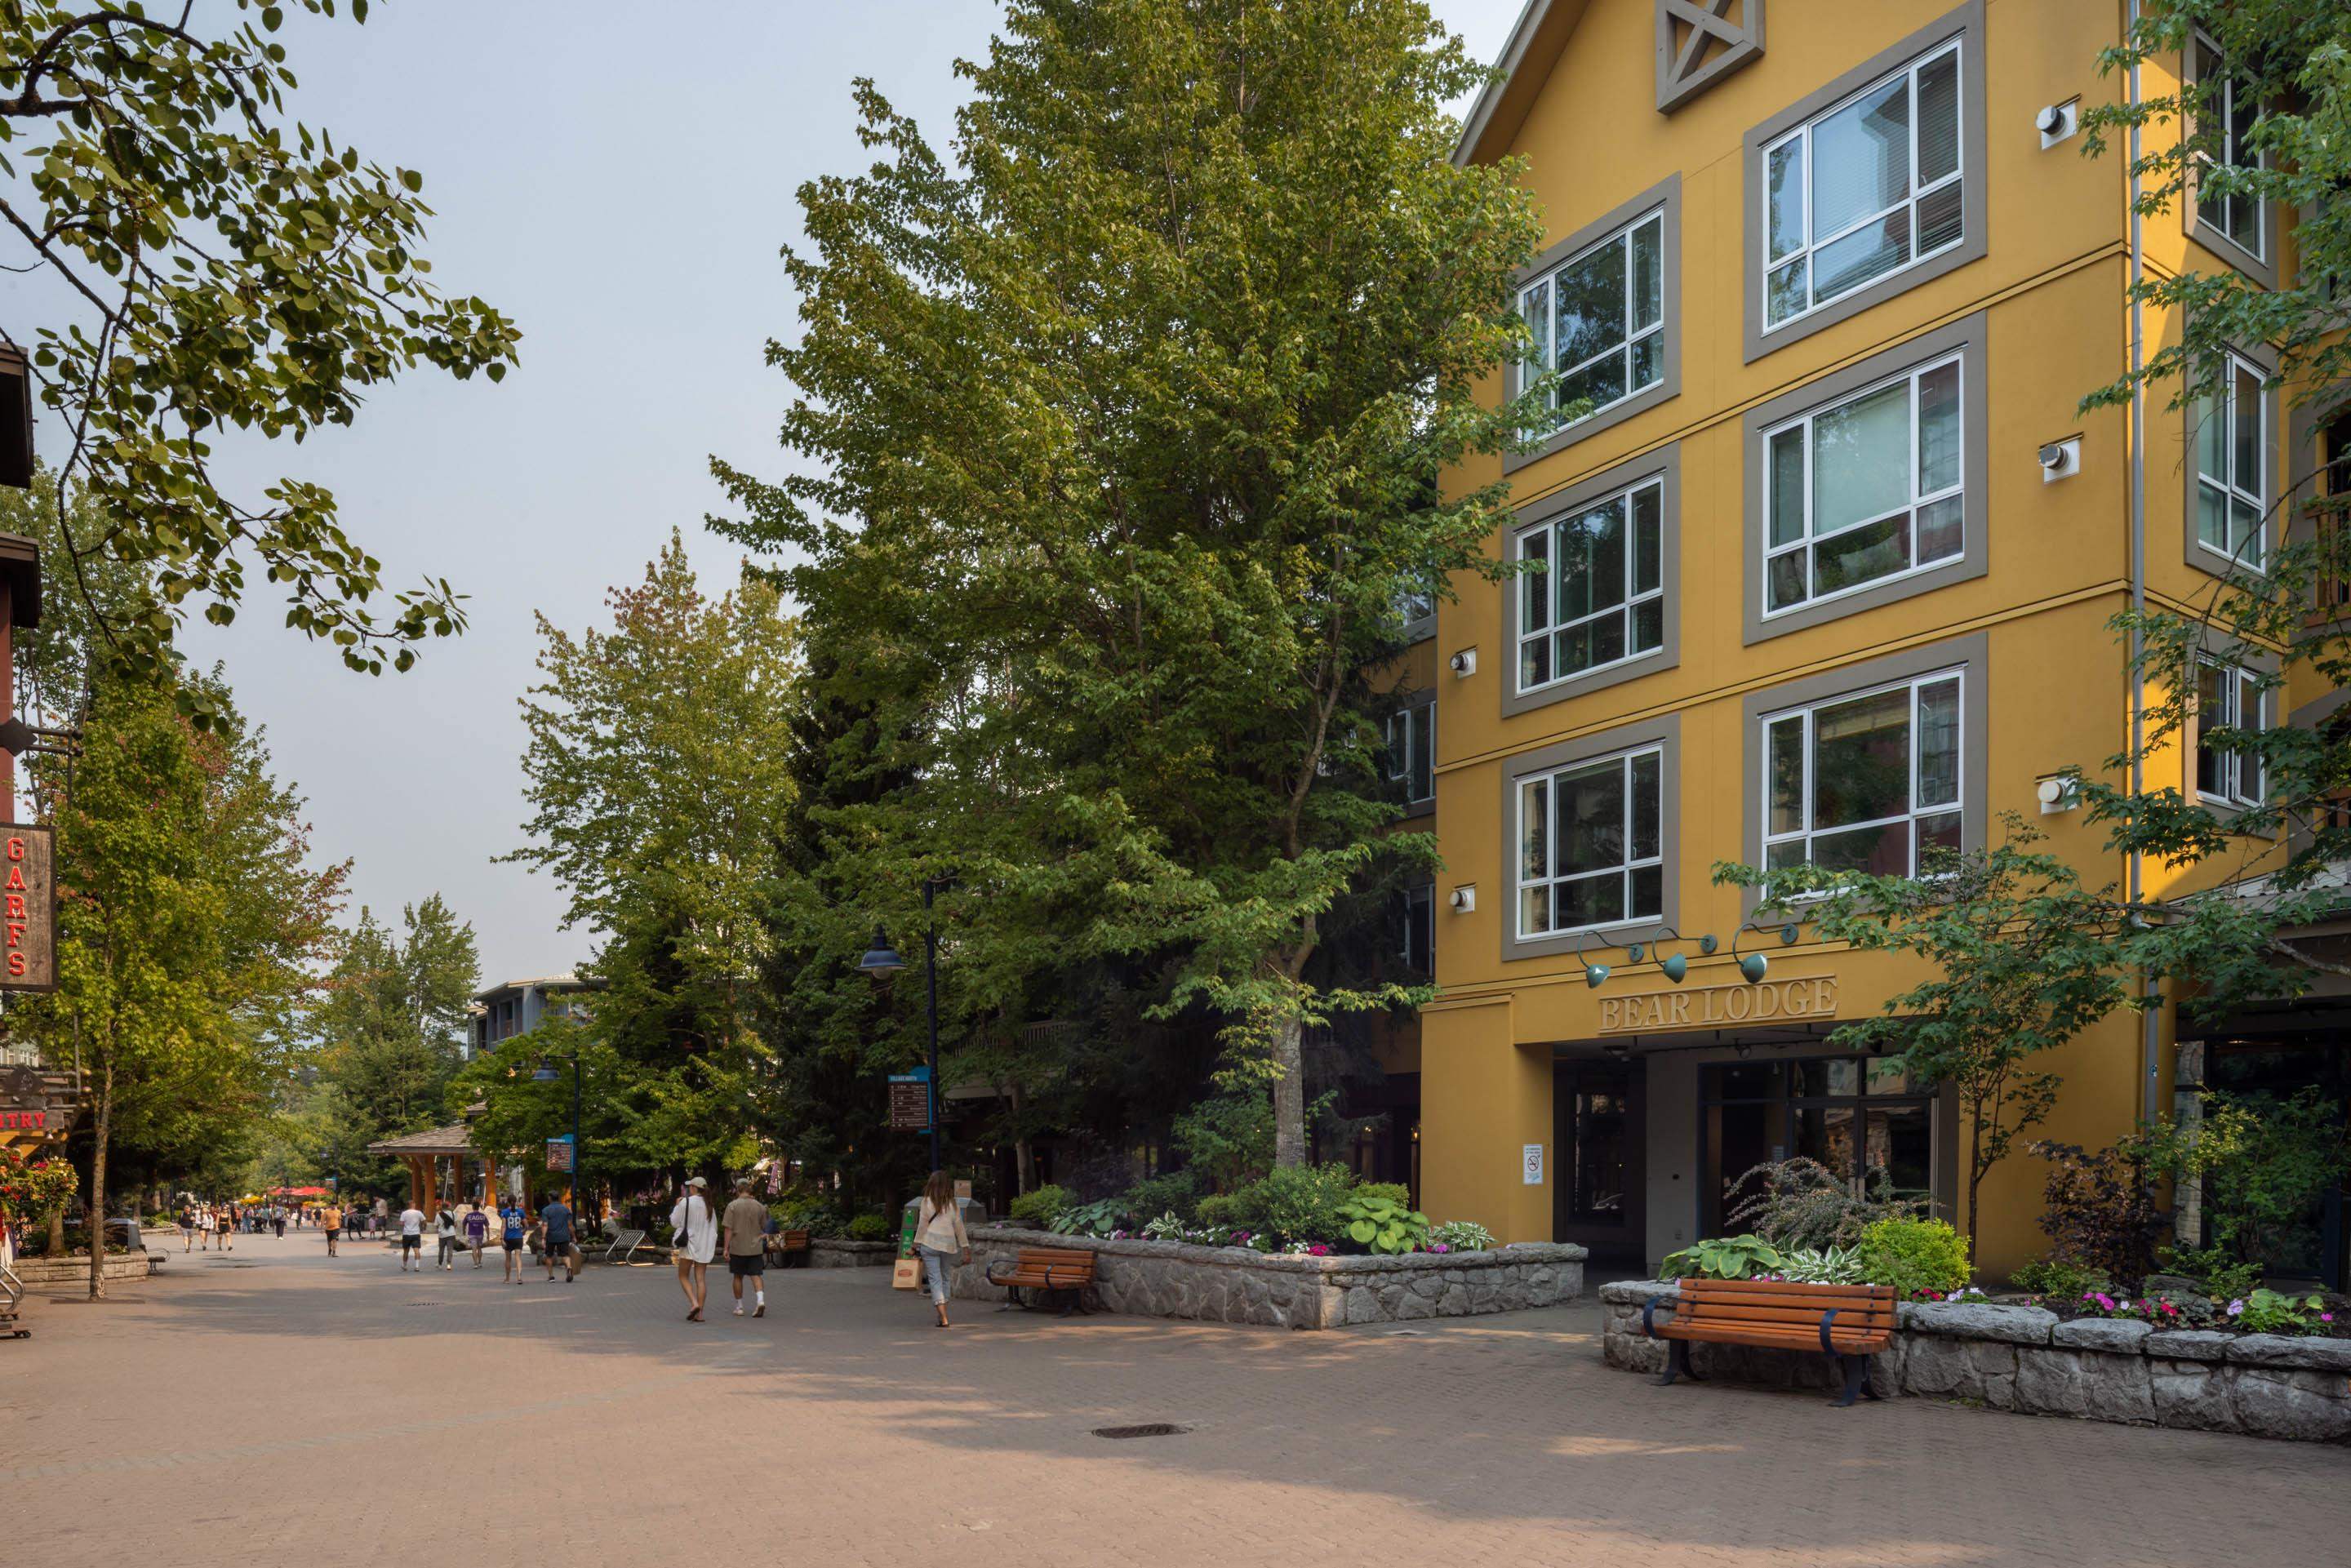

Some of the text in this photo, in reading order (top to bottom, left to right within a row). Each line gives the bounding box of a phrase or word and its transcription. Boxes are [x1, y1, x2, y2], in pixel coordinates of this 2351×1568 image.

[6, 837, 27, 977] GARFS
[1600, 978, 1838, 1031] BEAR LODGE
[508, 1216, 522, 1228] 88
